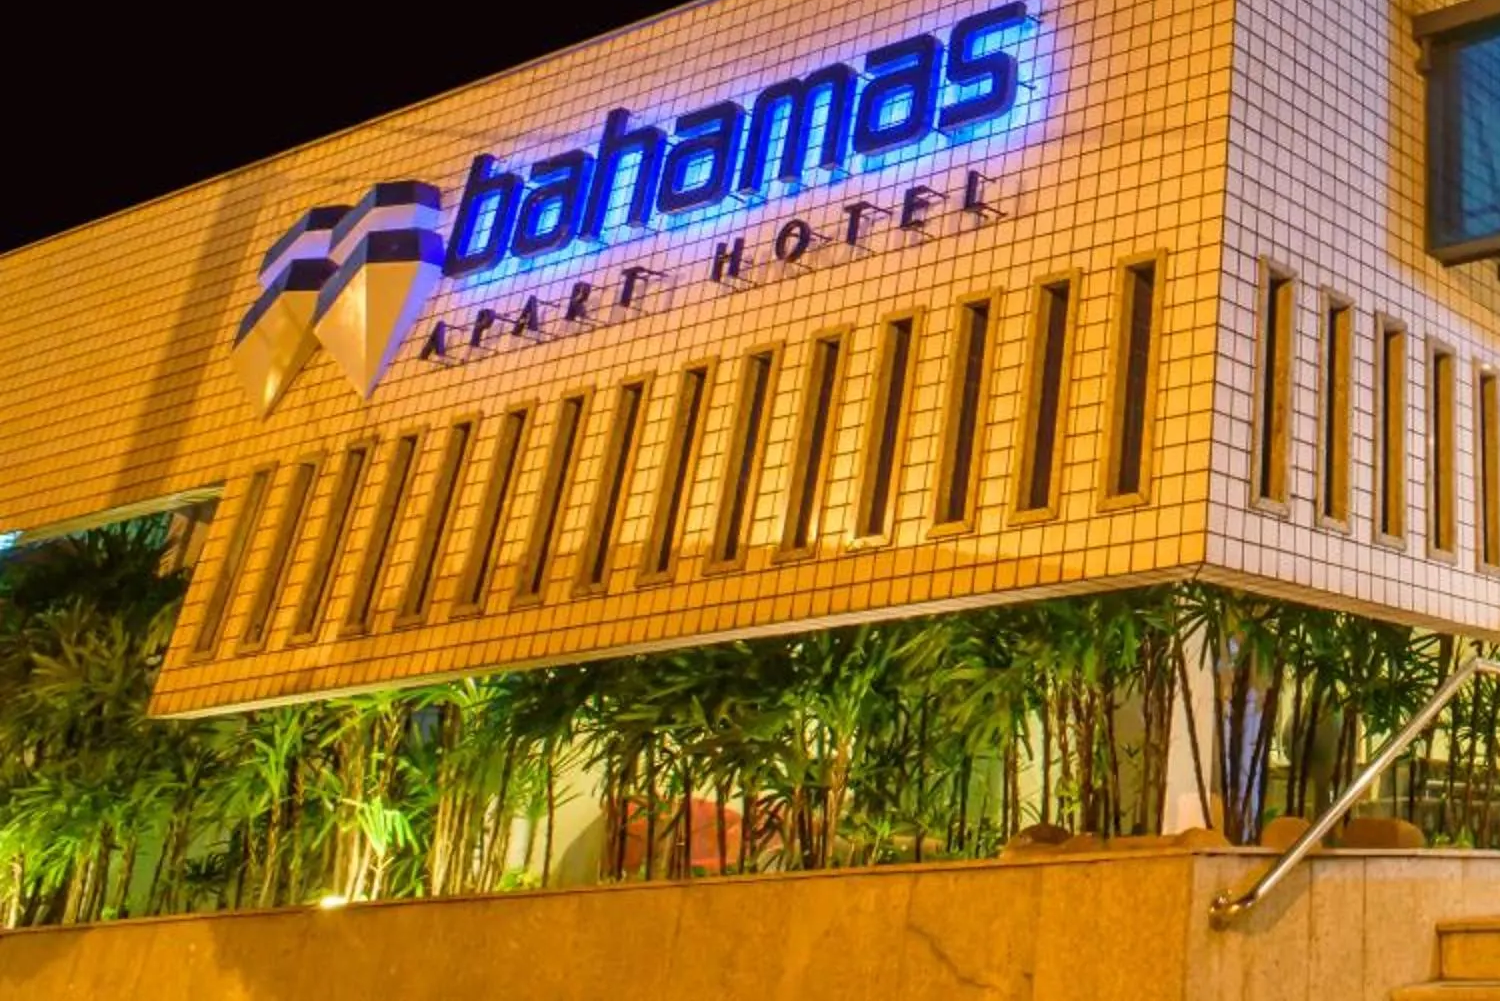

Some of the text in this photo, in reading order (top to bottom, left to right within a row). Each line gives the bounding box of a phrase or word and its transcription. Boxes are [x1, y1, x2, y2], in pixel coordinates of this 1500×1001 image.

[442, 0, 1027, 277] bahamas
[419, 170, 988, 360] APART HOTEL
